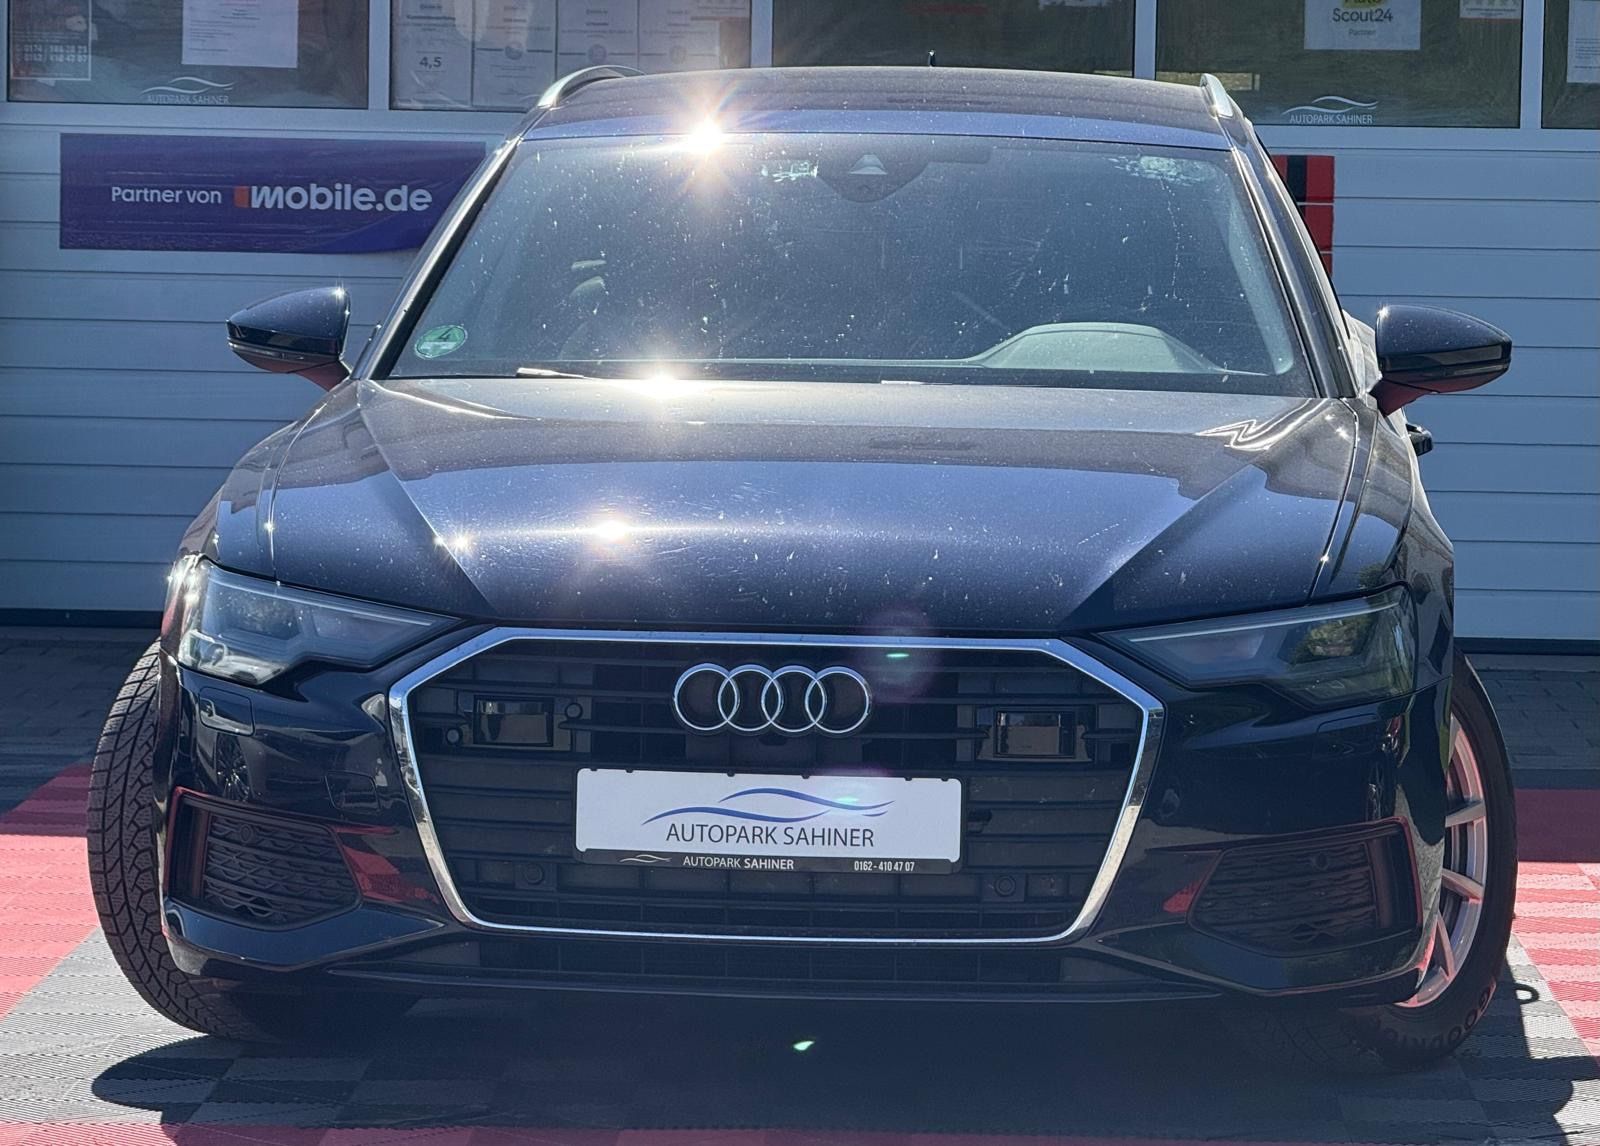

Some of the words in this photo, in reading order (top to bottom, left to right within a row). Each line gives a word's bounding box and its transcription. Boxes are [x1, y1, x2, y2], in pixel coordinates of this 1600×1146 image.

[1332, 7, 1393, 22] Scout24
[419, 56, 442, 69] 4,5
[147, 94, 190, 104] AUTOPARK
[192, 95, 231, 105] SAHINER
[1290, 114, 1334, 124] AUTOPARK
[1336, 114, 1373, 125] SAHINER
[111, 186, 182, 203] Partner
[187, 190, 222, 204] von
[251, 183, 433, 212] mobile.de
[666, 823, 778, 845] AUTOPARK
[783, 826, 875, 847] SAHINER
[683, 855, 741, 868] AUTOPARK
[744, 858, 794, 870] SAHINER
[878, 861, 893, 872] 410
[893, 861, 903, 872] 47
[905, 862, 915, 872] 07
